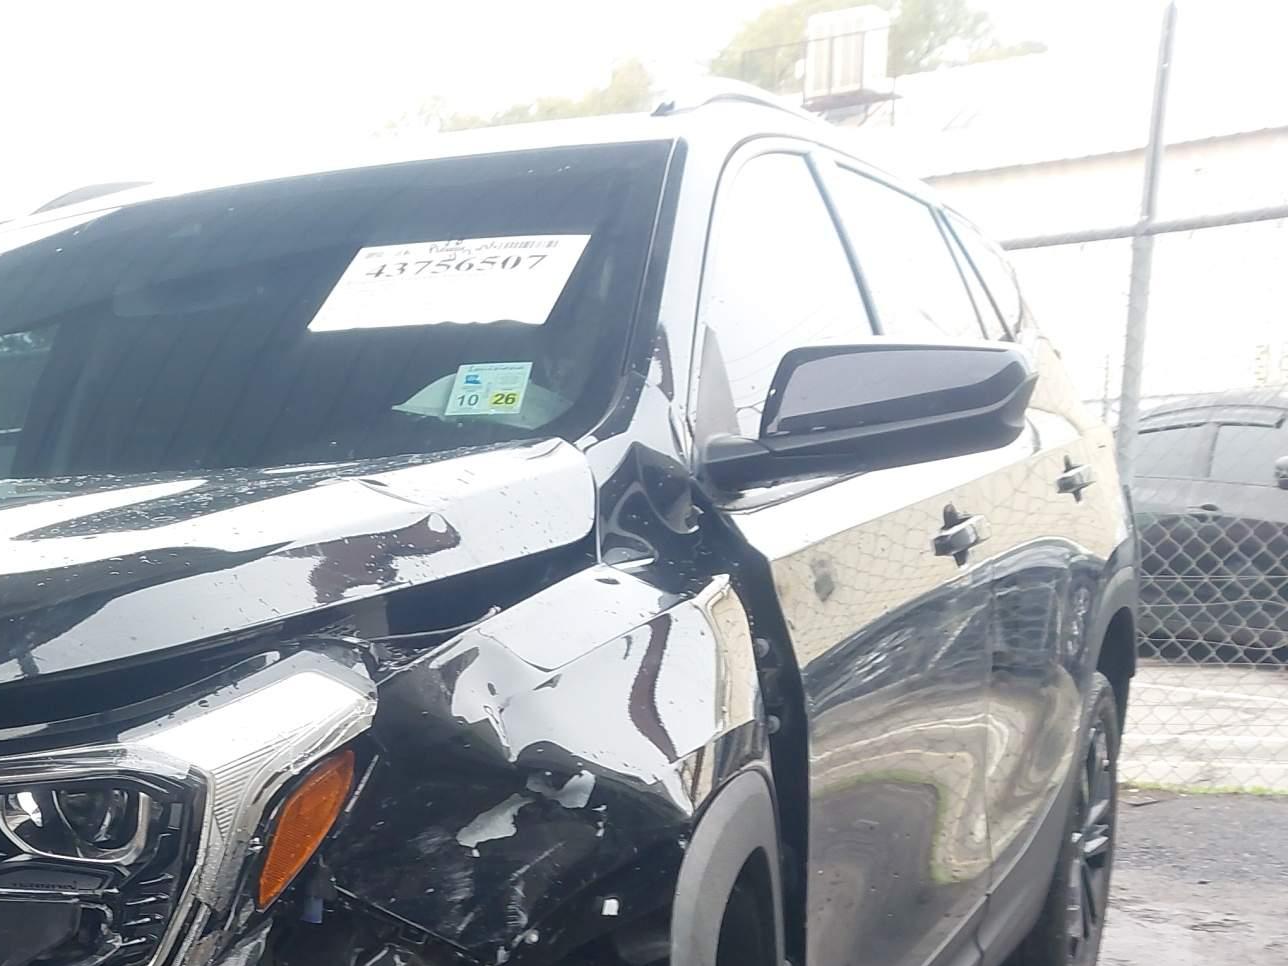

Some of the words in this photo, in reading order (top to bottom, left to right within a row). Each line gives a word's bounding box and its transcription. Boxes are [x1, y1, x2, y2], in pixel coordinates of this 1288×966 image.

[365, 254, 548, 278] 43756507
[457, 393, 480, 407] 10
[492, 392, 517, 405] 26
